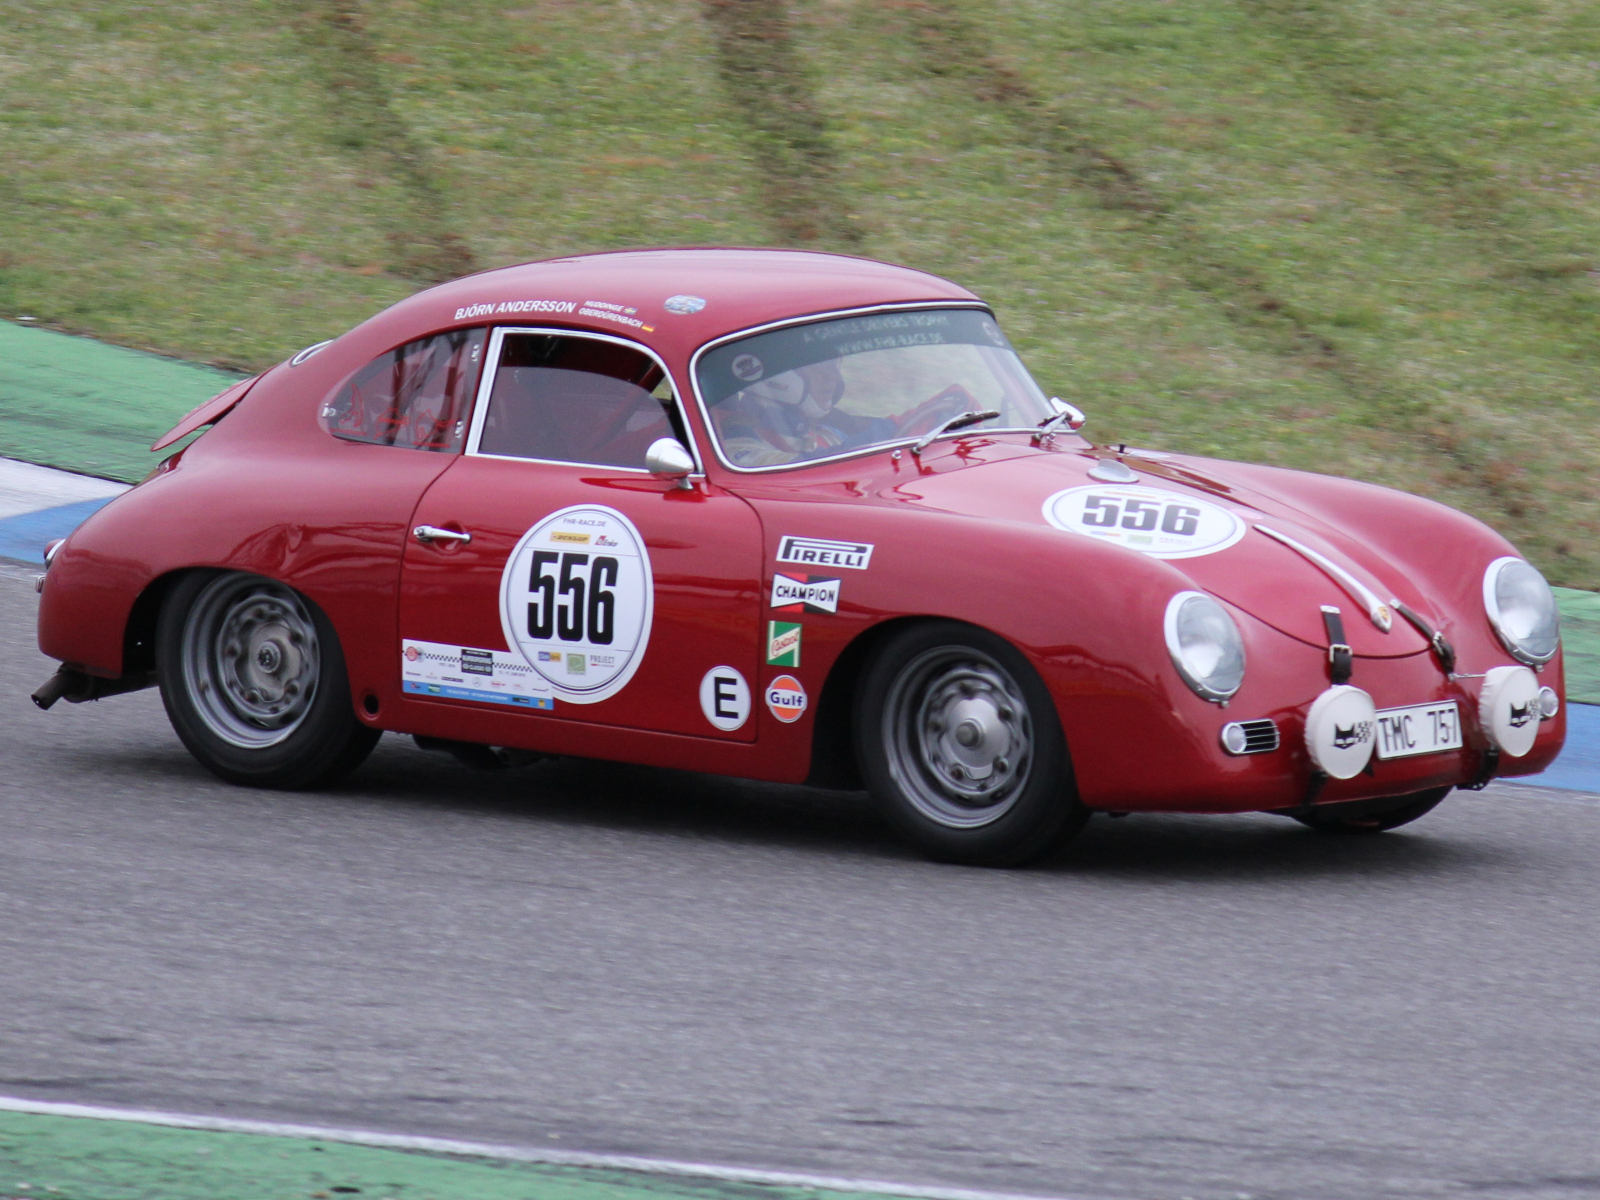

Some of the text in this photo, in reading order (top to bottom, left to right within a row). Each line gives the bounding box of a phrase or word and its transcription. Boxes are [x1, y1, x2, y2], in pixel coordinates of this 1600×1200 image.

[454, 300, 577, 320] BJÖRN ANDERSSON
[584, 300, 625, 312] HUDDINGE
[578, 307, 644, 328] OBERDÜRENBACH
[860, 316, 909, 331] DRIVERS
[562, 517, 607, 527] FHR-RACE.DE
[1082, 495, 1201, 536] 556
[782, 538, 868, 567] PIRELLI
[527, 550, 619, 645] 556
[776, 585, 836, 602] CHAMPION
[771, 631, 800, 657] Castrol
[590, 655, 615, 664] PROJECT
[713, 676, 739, 719] E
[770, 691, 804, 706] Gulf
[1378, 708, 1458, 753] TMC 757
